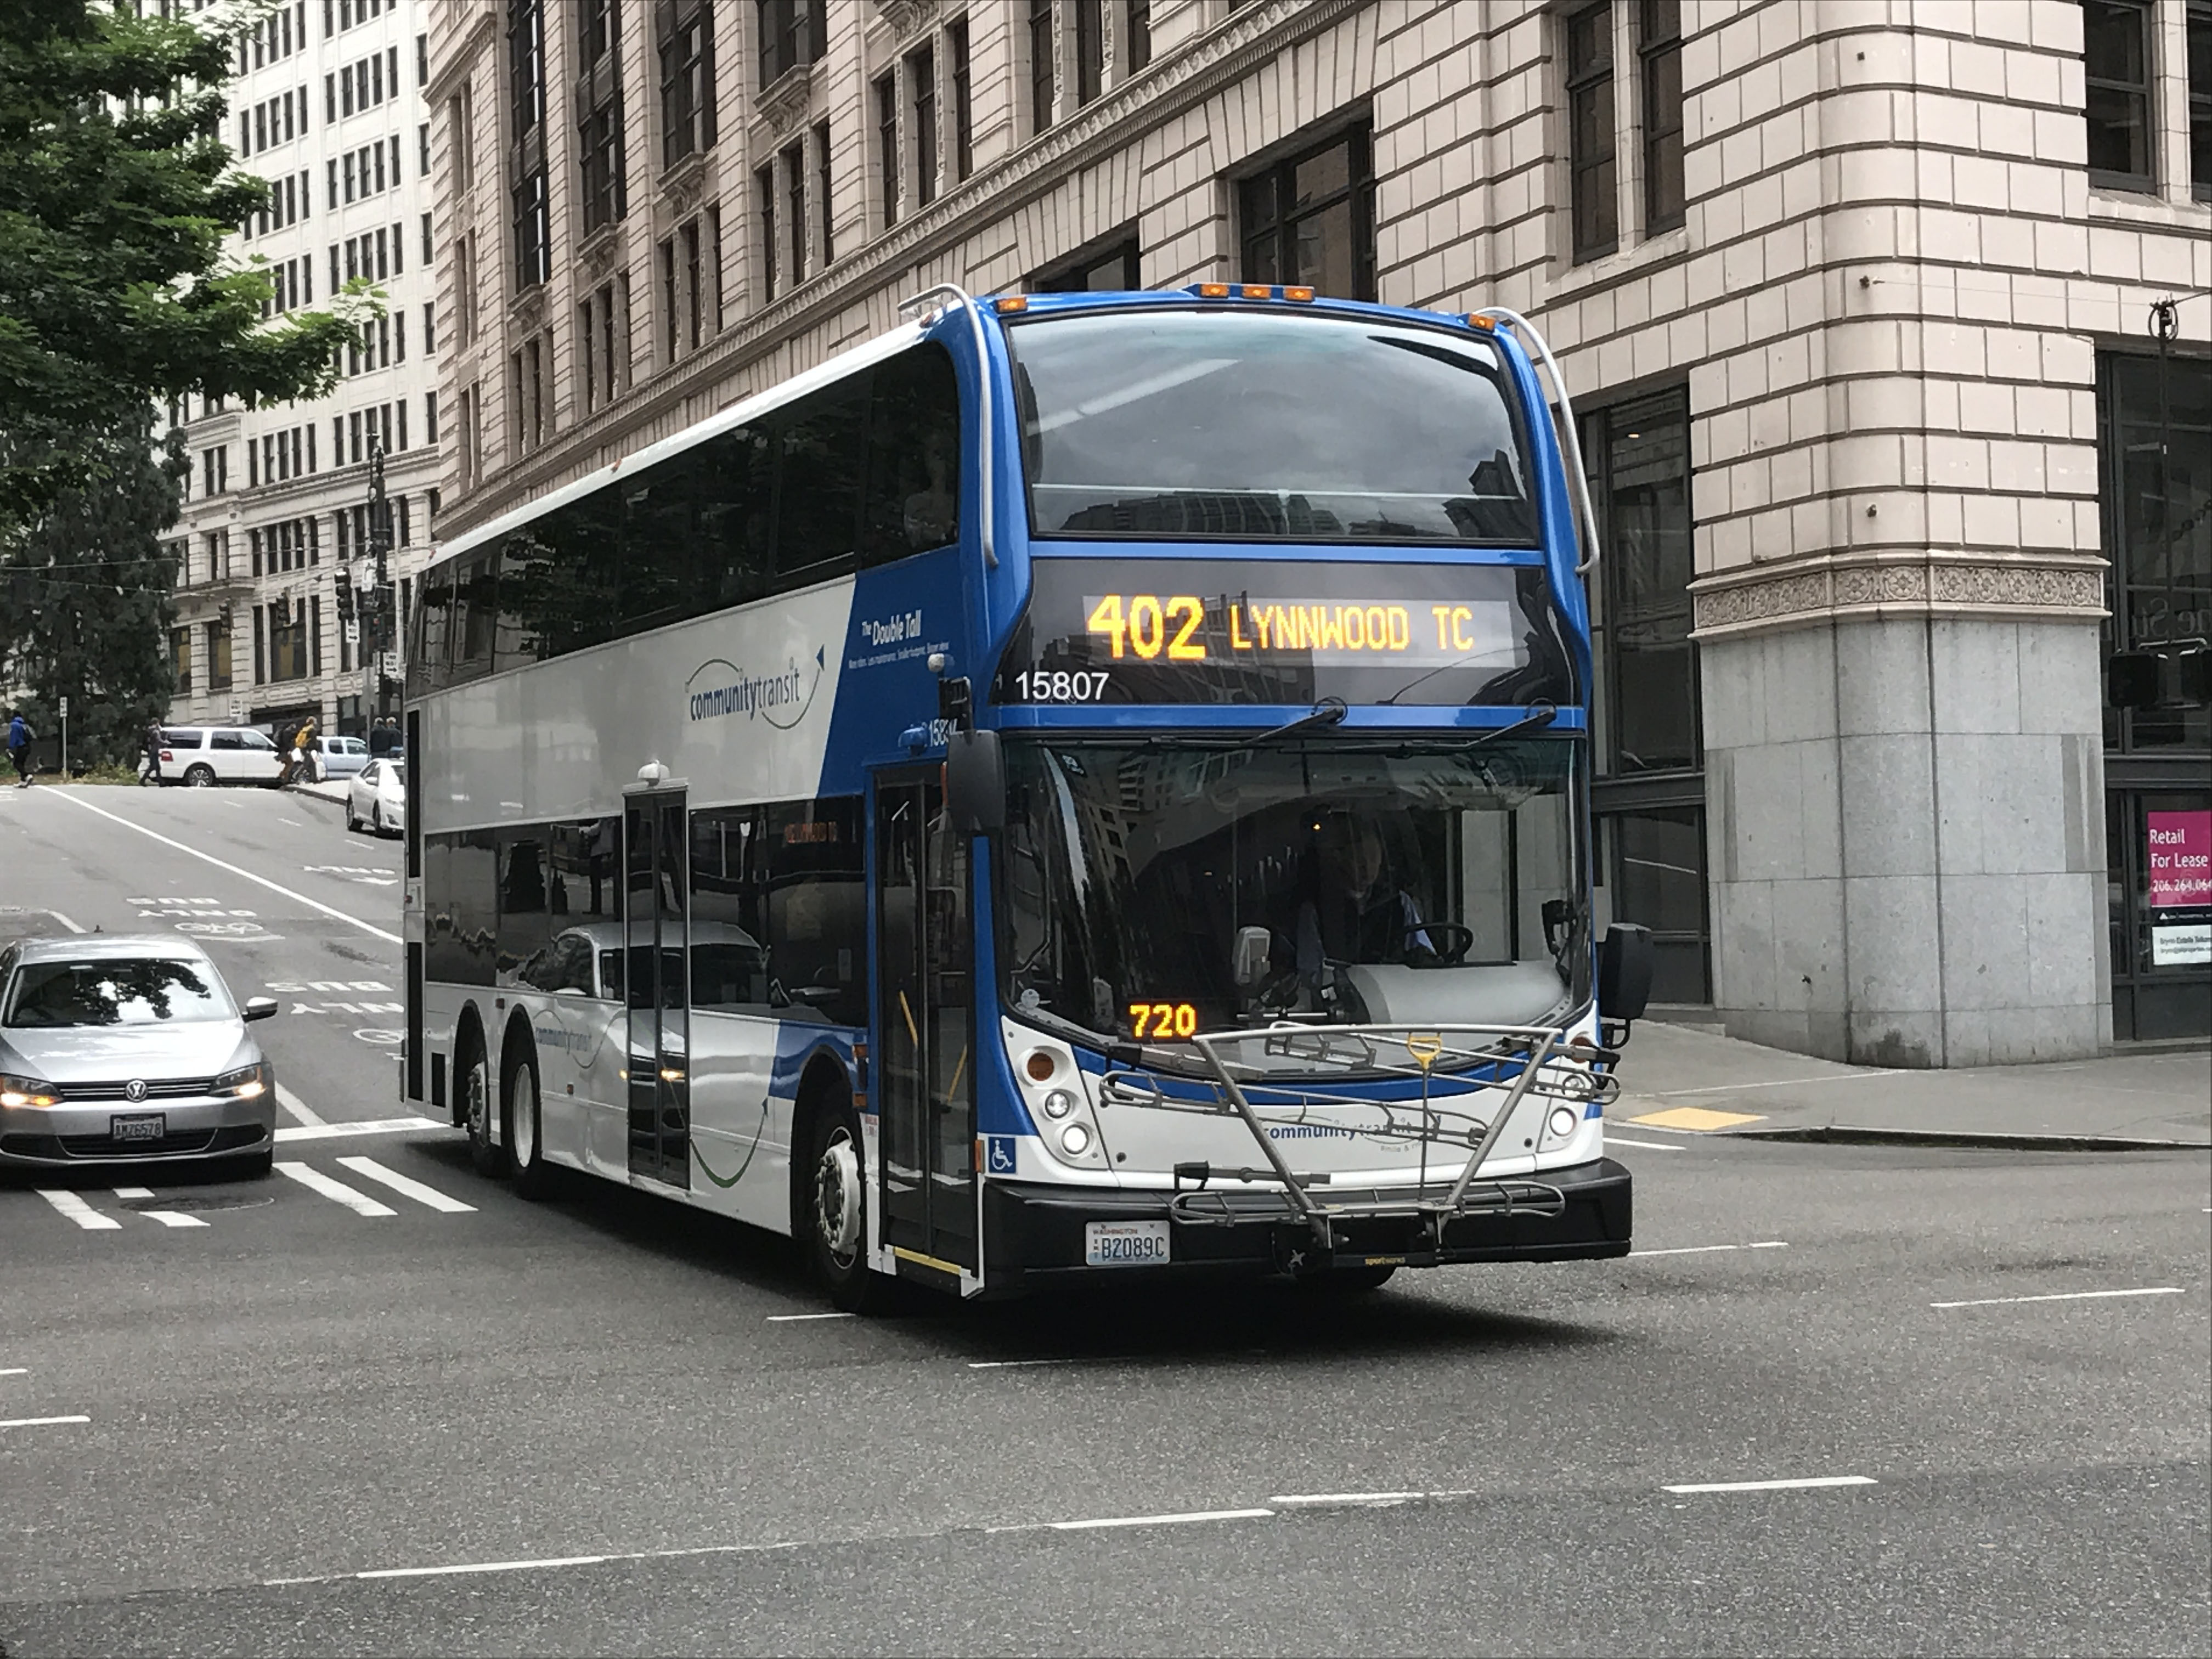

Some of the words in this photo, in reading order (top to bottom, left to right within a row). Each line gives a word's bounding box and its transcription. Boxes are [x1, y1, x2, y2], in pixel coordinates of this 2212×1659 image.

[872, 614, 904, 646] Double
[905, 610, 922, 639] Tall
[1088, 595, 1206, 659] 402
[1231, 605, 1409, 650] LYNNWOOD
[1432, 606, 1474, 650] TC
[690, 659, 800, 721] communitytransit
[1015, 670, 1110, 701] 15807
[2149, 828, 2185, 844] Retail
[2151, 853, 2171, 868] For
[2175, 853, 2209, 867] Lease
[265, 981, 394, 991] BUS
[291, 1002, 404, 1014] NLY
[1130, 1003, 1196, 1037] 720
[1102, 1236, 1165, 1258] B2089C
